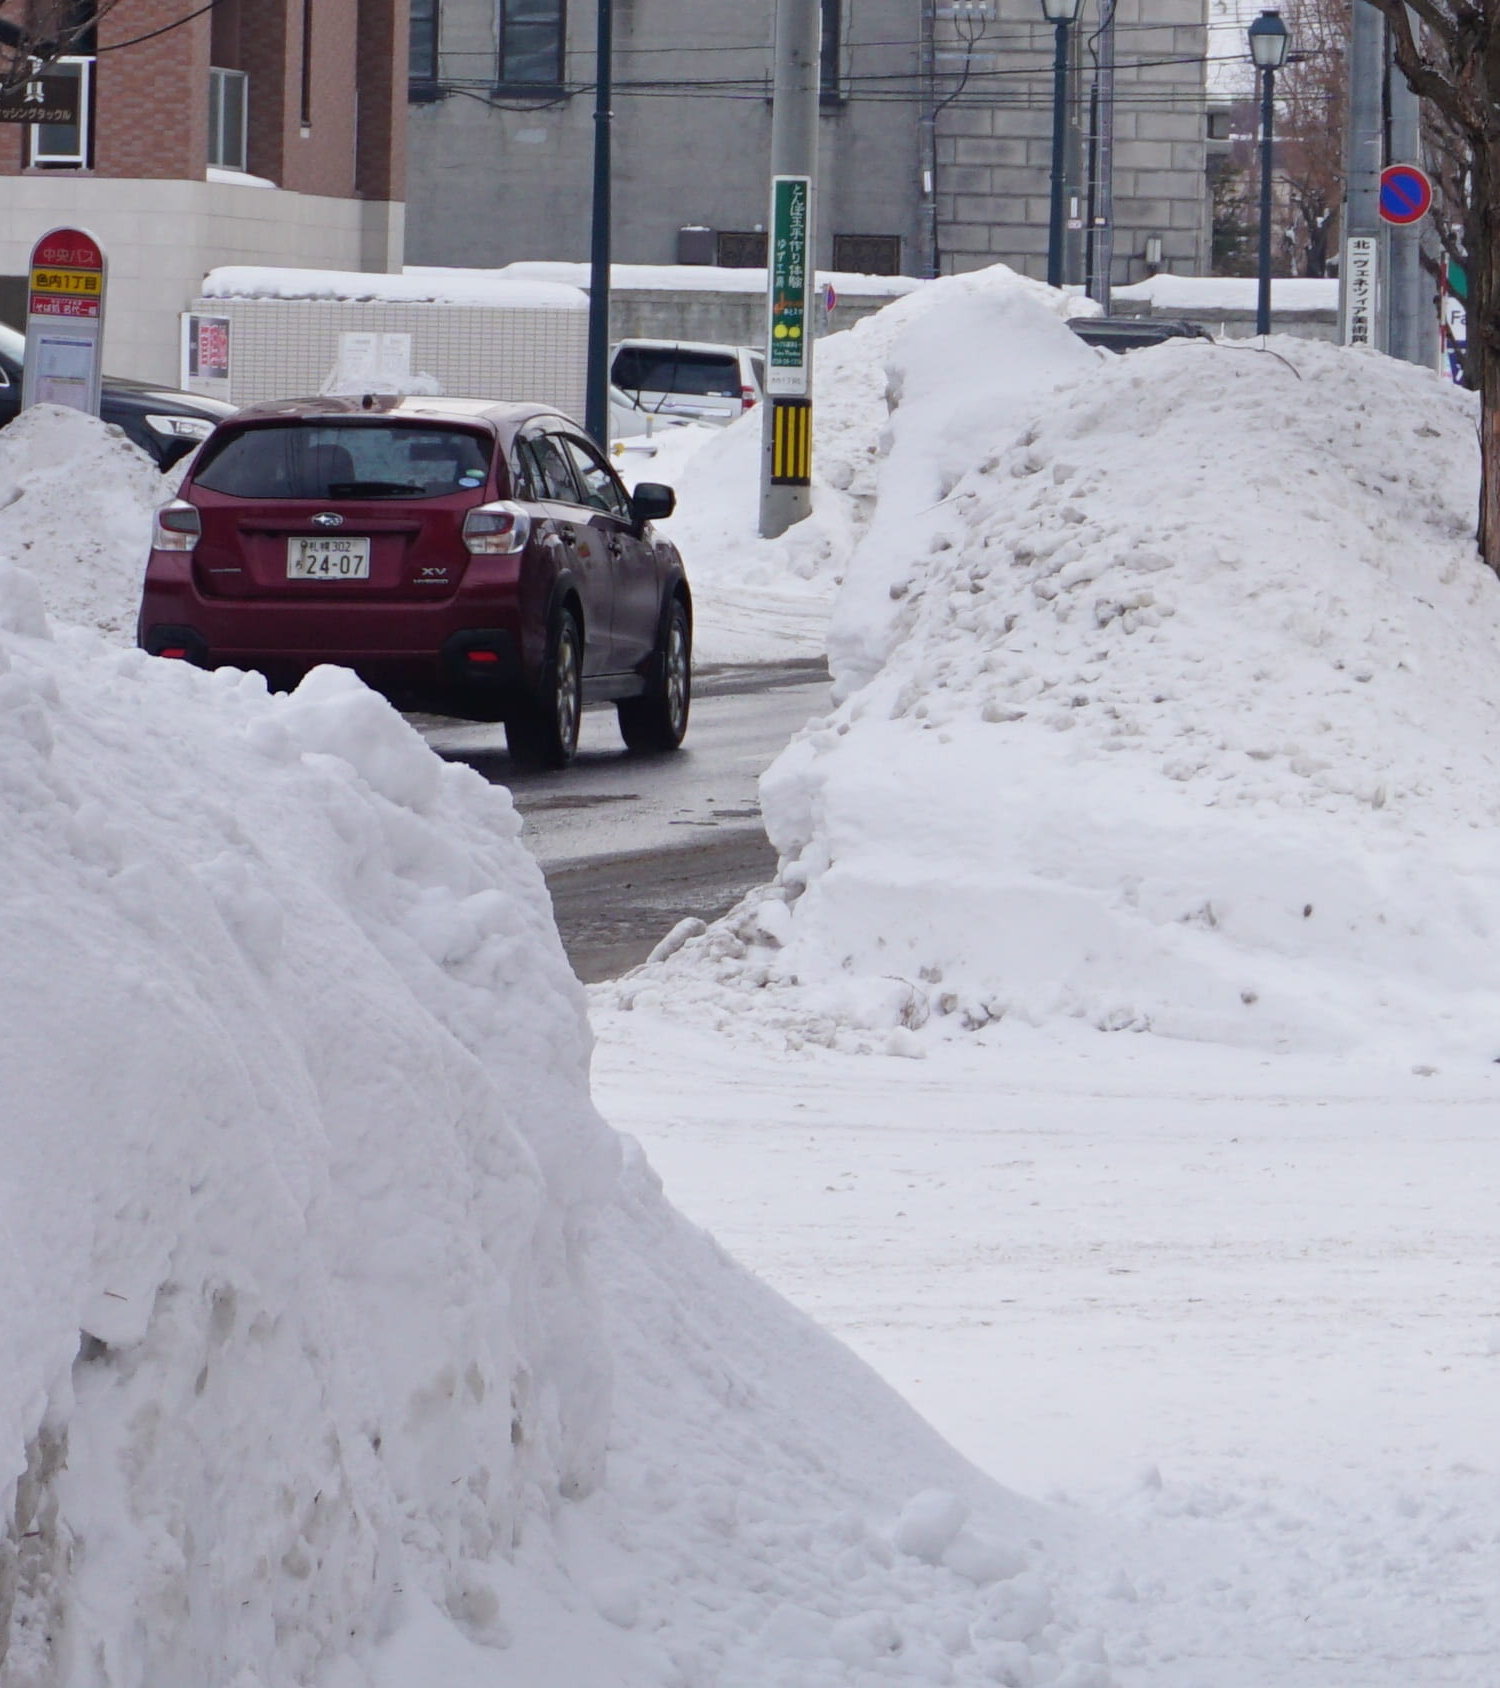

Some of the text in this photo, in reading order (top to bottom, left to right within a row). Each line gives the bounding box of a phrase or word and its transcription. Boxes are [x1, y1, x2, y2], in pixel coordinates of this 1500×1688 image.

[43, 247, 94, 264] 中央バス
[36, 273, 97, 290] 色内1丁目
[332, 541, 352, 552] 302
[306, 554, 363, 575] 24-07
[421, 567, 447, 576] XV
